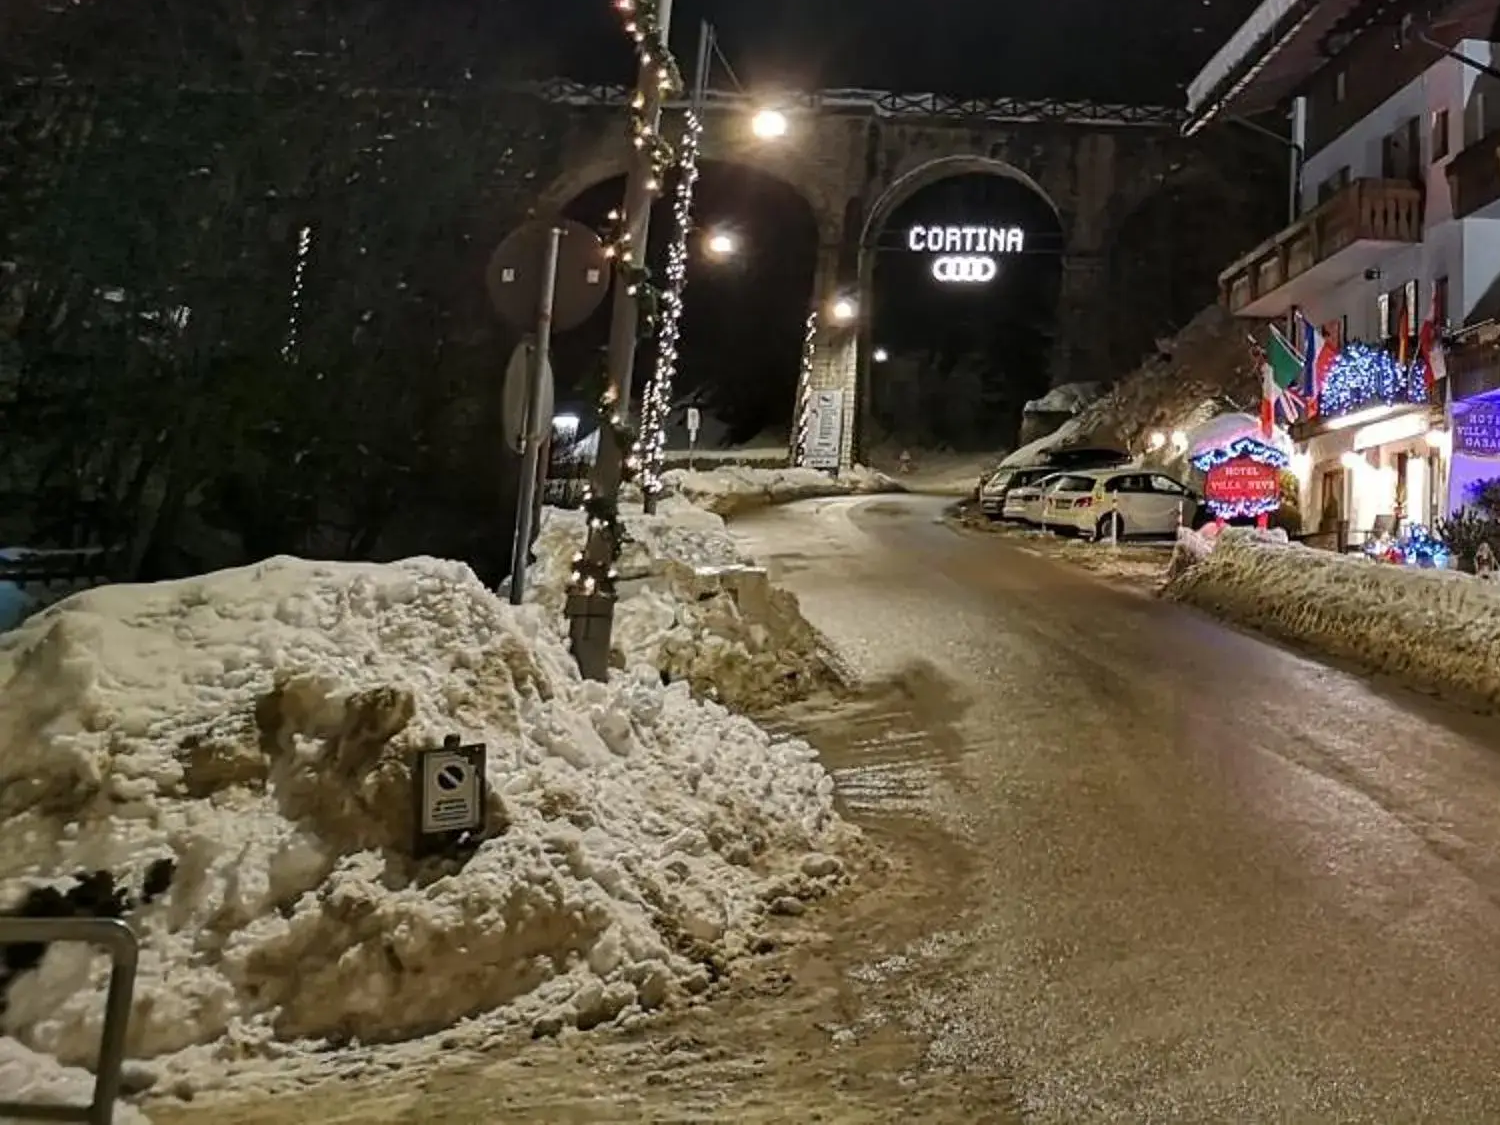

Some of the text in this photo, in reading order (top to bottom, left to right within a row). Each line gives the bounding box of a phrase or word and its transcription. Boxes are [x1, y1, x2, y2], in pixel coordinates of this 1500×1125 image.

[909, 226, 1024, 252] CORTINA
[1225, 466, 1259, 476] HOTEL
[1210, 480, 1276, 490] VILLA NEVE
